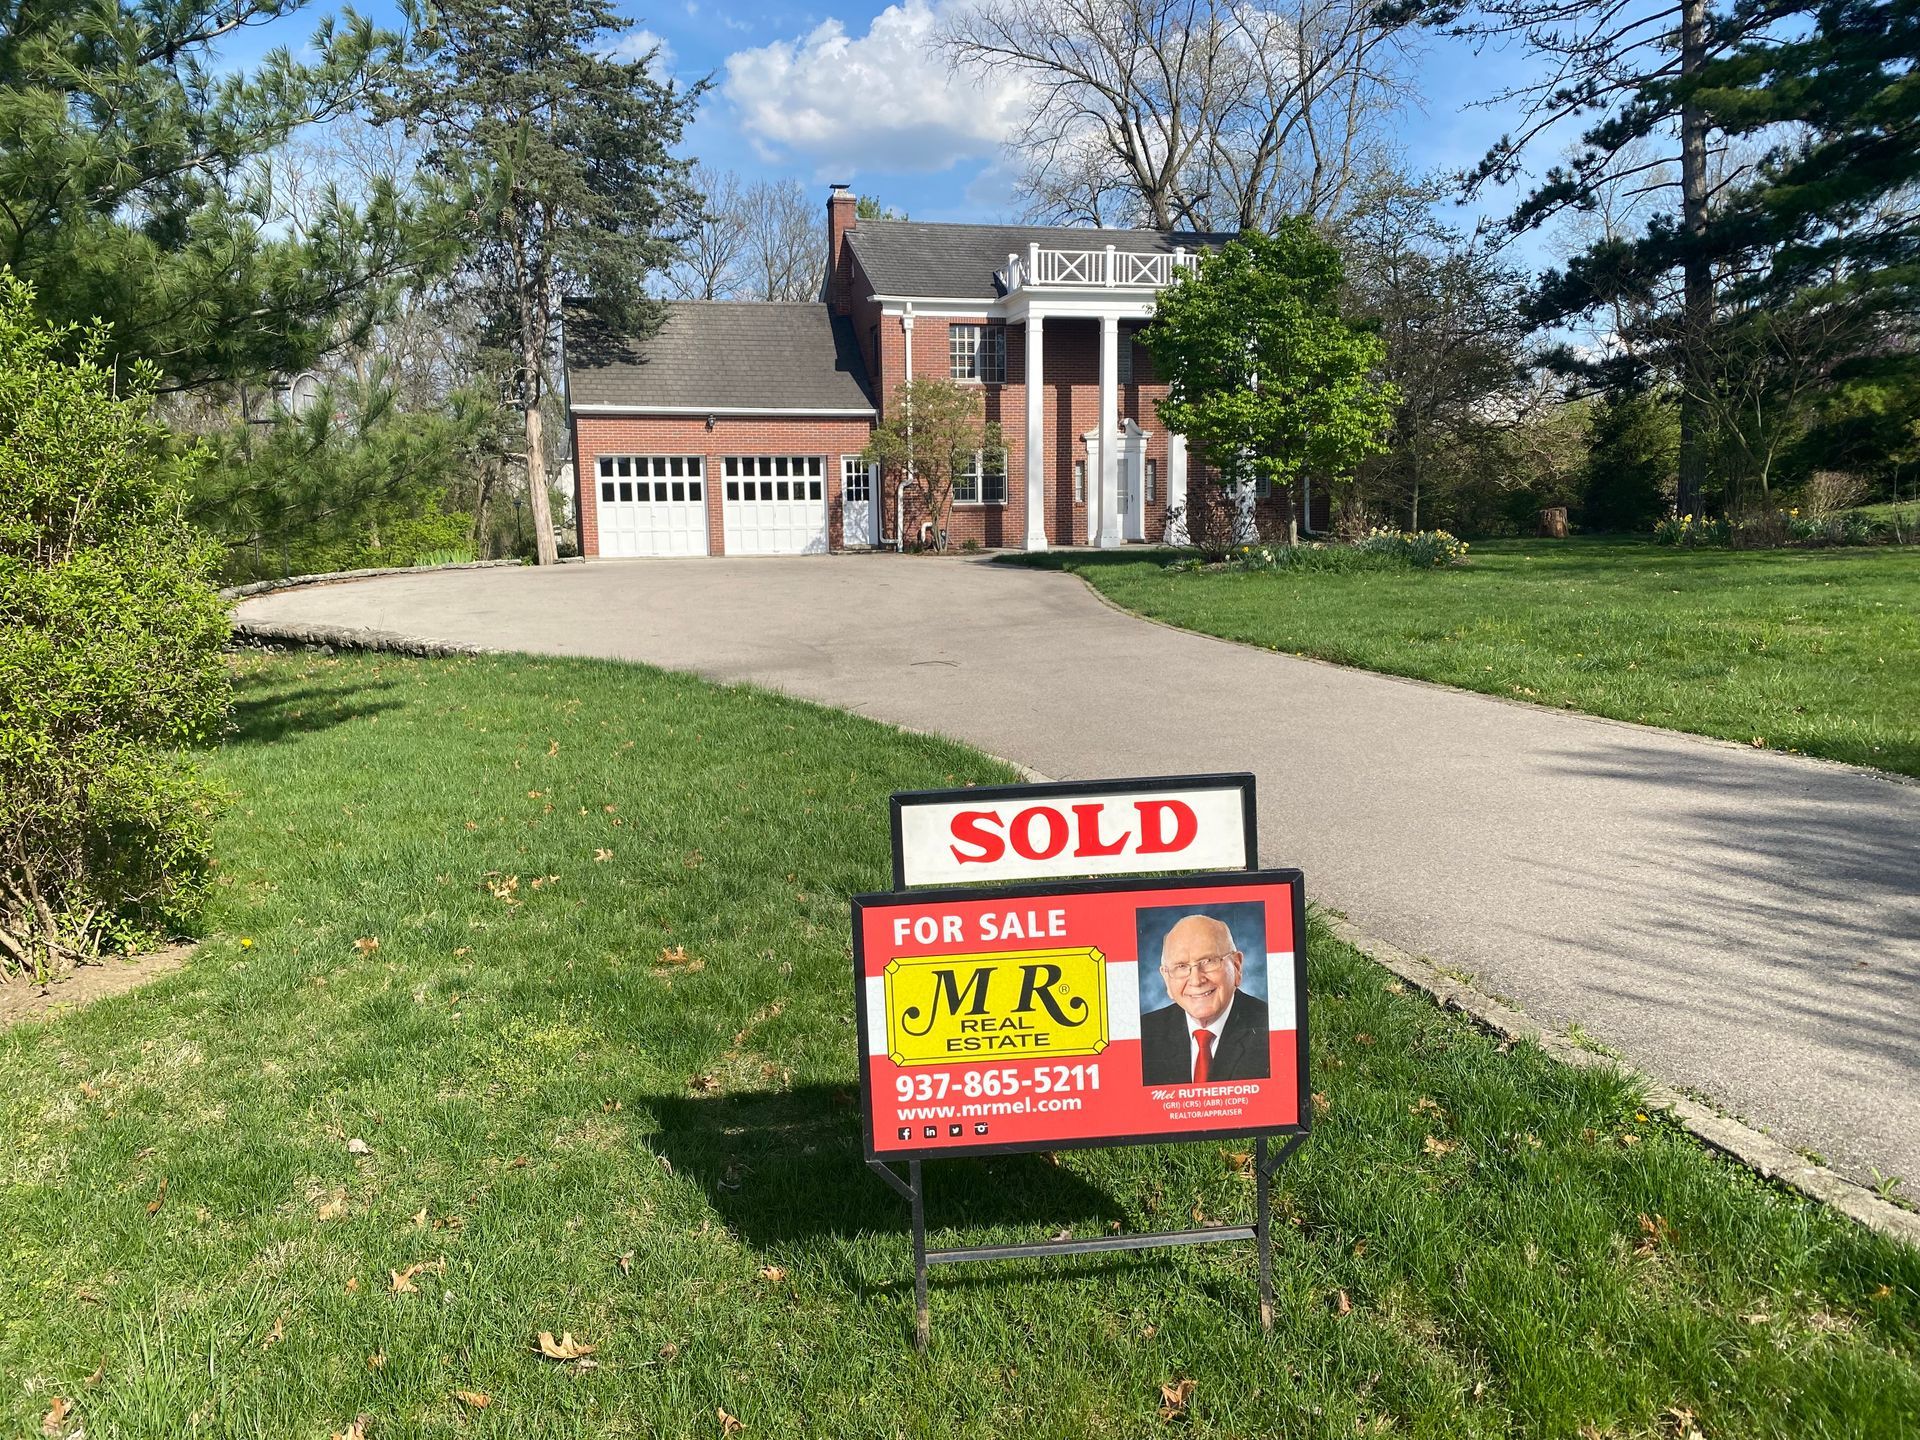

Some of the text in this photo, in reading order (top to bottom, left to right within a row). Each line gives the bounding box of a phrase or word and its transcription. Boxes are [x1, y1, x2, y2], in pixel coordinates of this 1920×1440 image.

[949, 799, 1198, 865] SOLD
[893, 909, 1067, 946] FOR SALE
[961, 1016, 1035, 1033] REAL
[946, 1033, 1050, 1052] ESTATE
[895, 1063, 1100, 1102] 937-865-5211
[1151, 1084, 1260, 1100] Mel RUTHERFORD
[896, 1096, 1082, 1121] www.mrmel.com
[1163, 1097, 1249, 1110] (GRI) (CRS) (ABR) (CDPE)
[1169, 1108, 1243, 1120] REALTOR/APPRAISER
